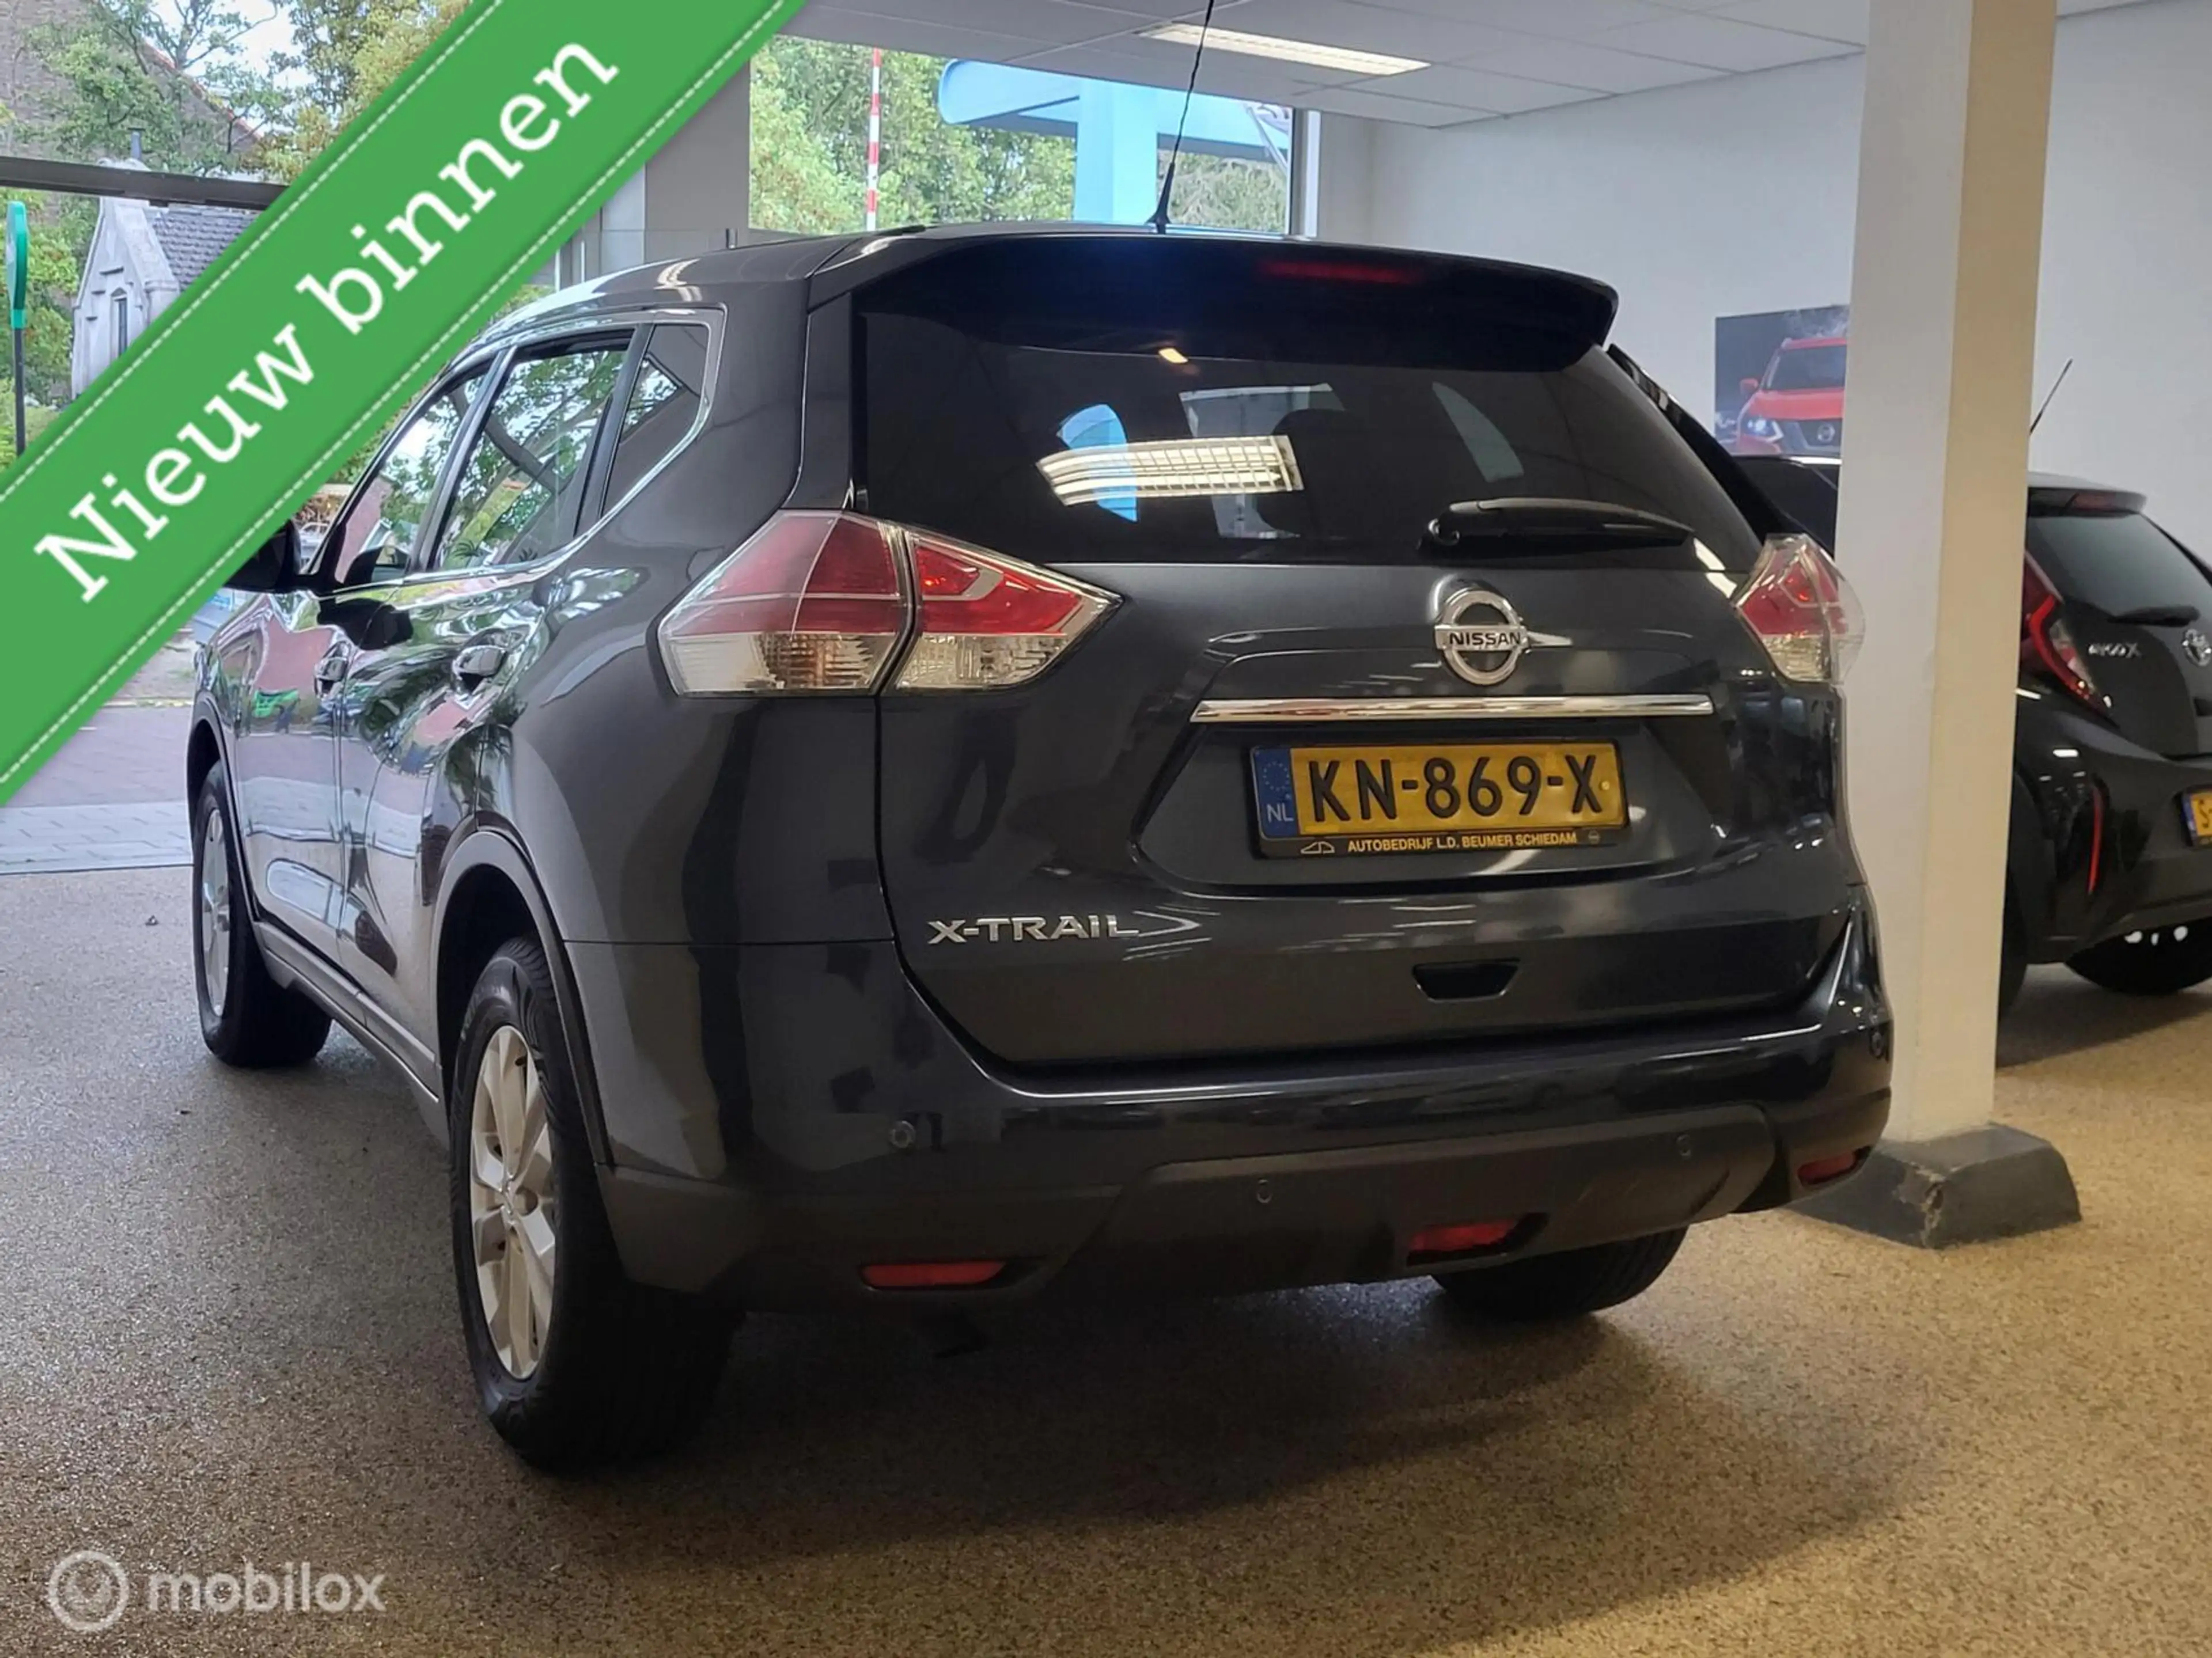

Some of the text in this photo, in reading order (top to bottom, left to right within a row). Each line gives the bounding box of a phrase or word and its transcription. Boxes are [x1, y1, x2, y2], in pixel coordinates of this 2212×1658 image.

[1449, 632, 1521, 646] NISSAN
[1308, 754, 1602, 822] KN-869-X
[1267, 803, 1294, 822] NL
[1347, 837, 1433, 852] AUTOBEDRIJF
[1461, 834, 1514, 848] BEUMER
[1515, 832, 1577, 845] SCHIEDAM
[928, 915, 1139, 944] X-TRAIL
